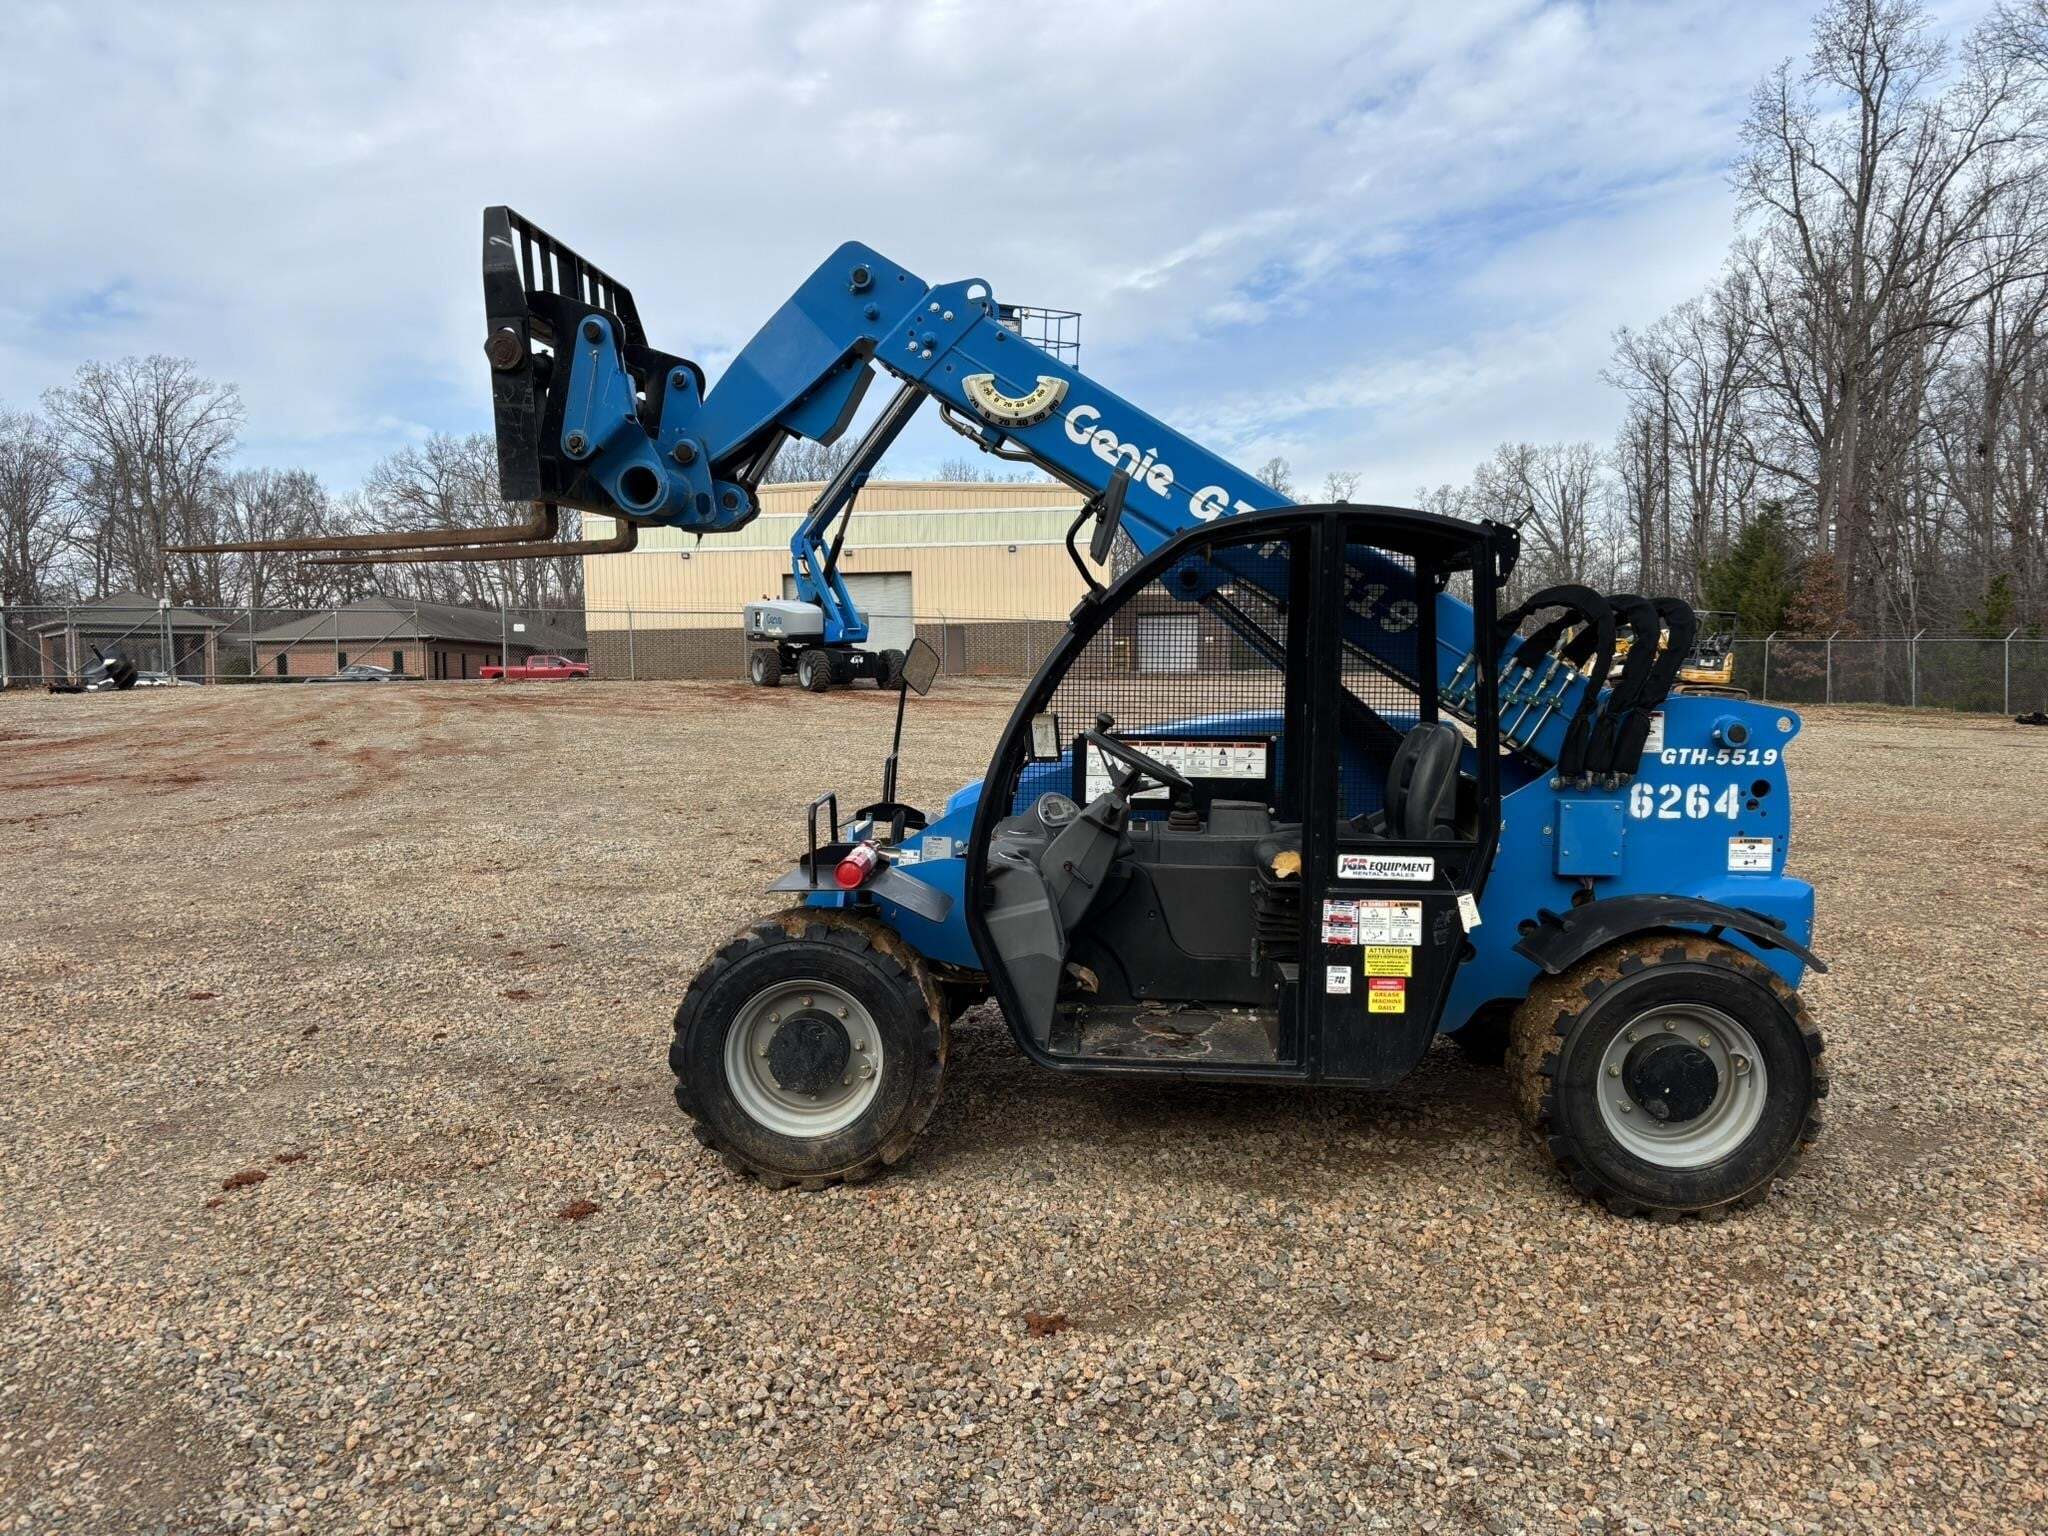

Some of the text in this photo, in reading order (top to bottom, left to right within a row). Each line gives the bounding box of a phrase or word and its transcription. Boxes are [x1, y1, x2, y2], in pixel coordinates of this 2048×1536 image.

[999, 418, 1011, 428] 20
[1064, 404, 1174, 497] Genie
[1661, 748, 1778, 766] GTH-5519
[1630, 782, 1740, 820] 6264
[1369, 861, 1432, 874] EQUIPMENT
